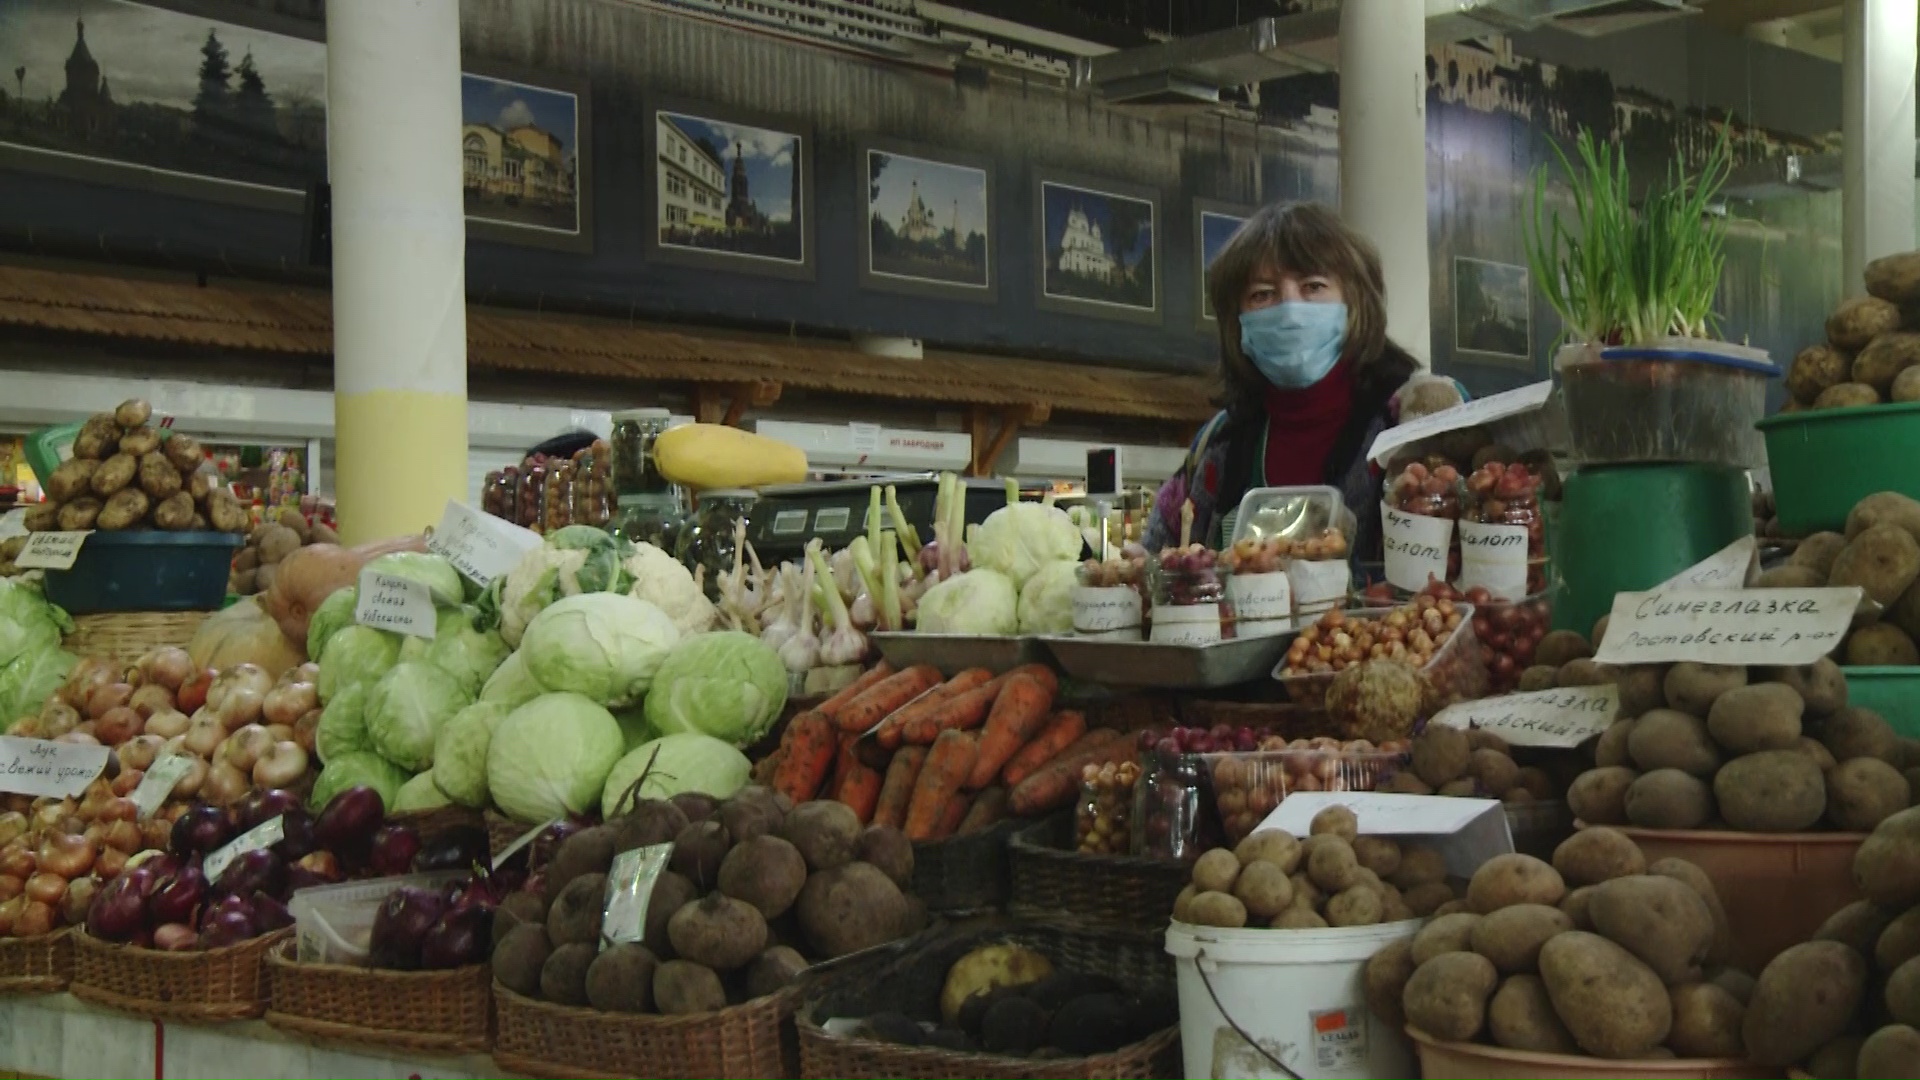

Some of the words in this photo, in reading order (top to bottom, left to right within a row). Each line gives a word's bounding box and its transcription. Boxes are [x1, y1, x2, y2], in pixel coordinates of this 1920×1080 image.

[1384, 536, 1441, 560] алот
[1238, 589, 1284, 605] овский
[1635, 591, 1819, 620] Синеглазка
[1619, 627, 1780, 650] Ростовский
[30, 743, 57, 758] Лук
